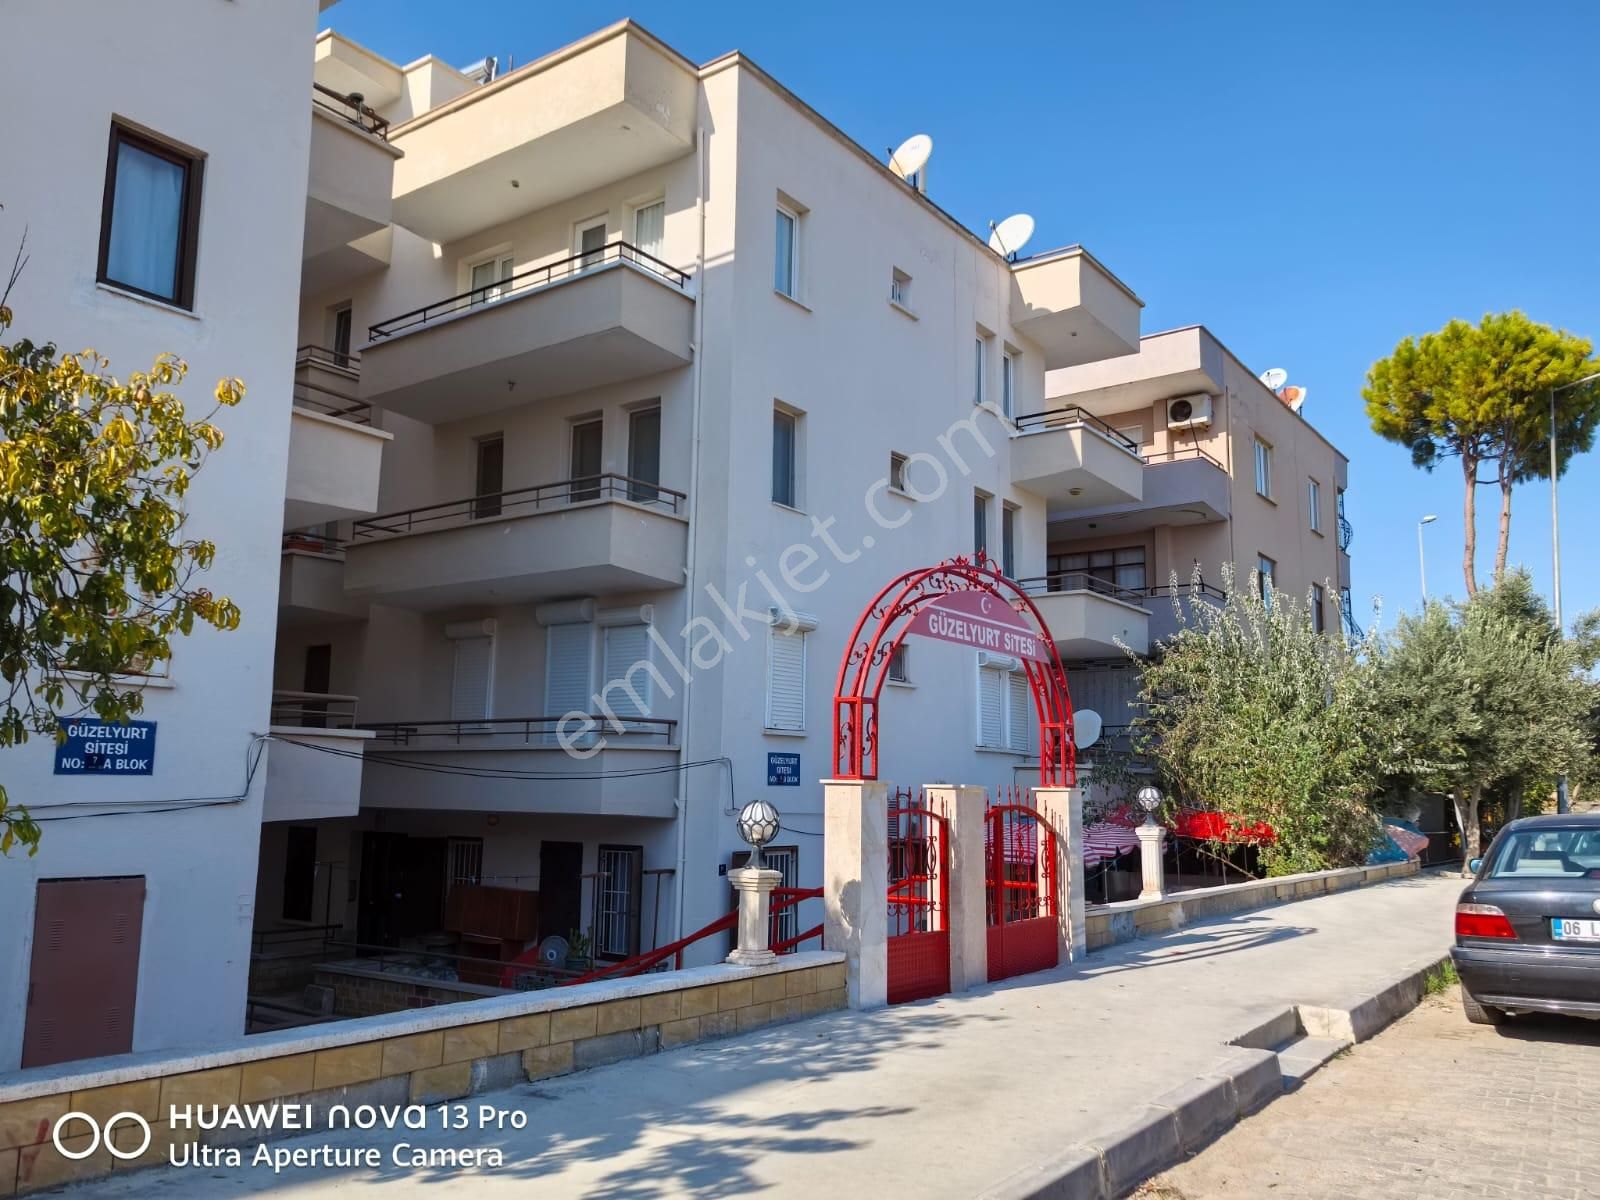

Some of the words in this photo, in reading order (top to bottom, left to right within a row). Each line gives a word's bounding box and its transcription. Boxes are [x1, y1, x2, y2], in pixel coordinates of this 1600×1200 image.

[928, 612, 1001, 648] GÜZELYURT
[67, 722, 148, 740] GÜZELYURT
[84, 740, 128, 755] SİTESİ
[61, 757, 85, 769] NO:
[103, 758, 112, 769] A
[115, 759, 148, 770] BLOK
[1563, 921, 1581, 935] 06
